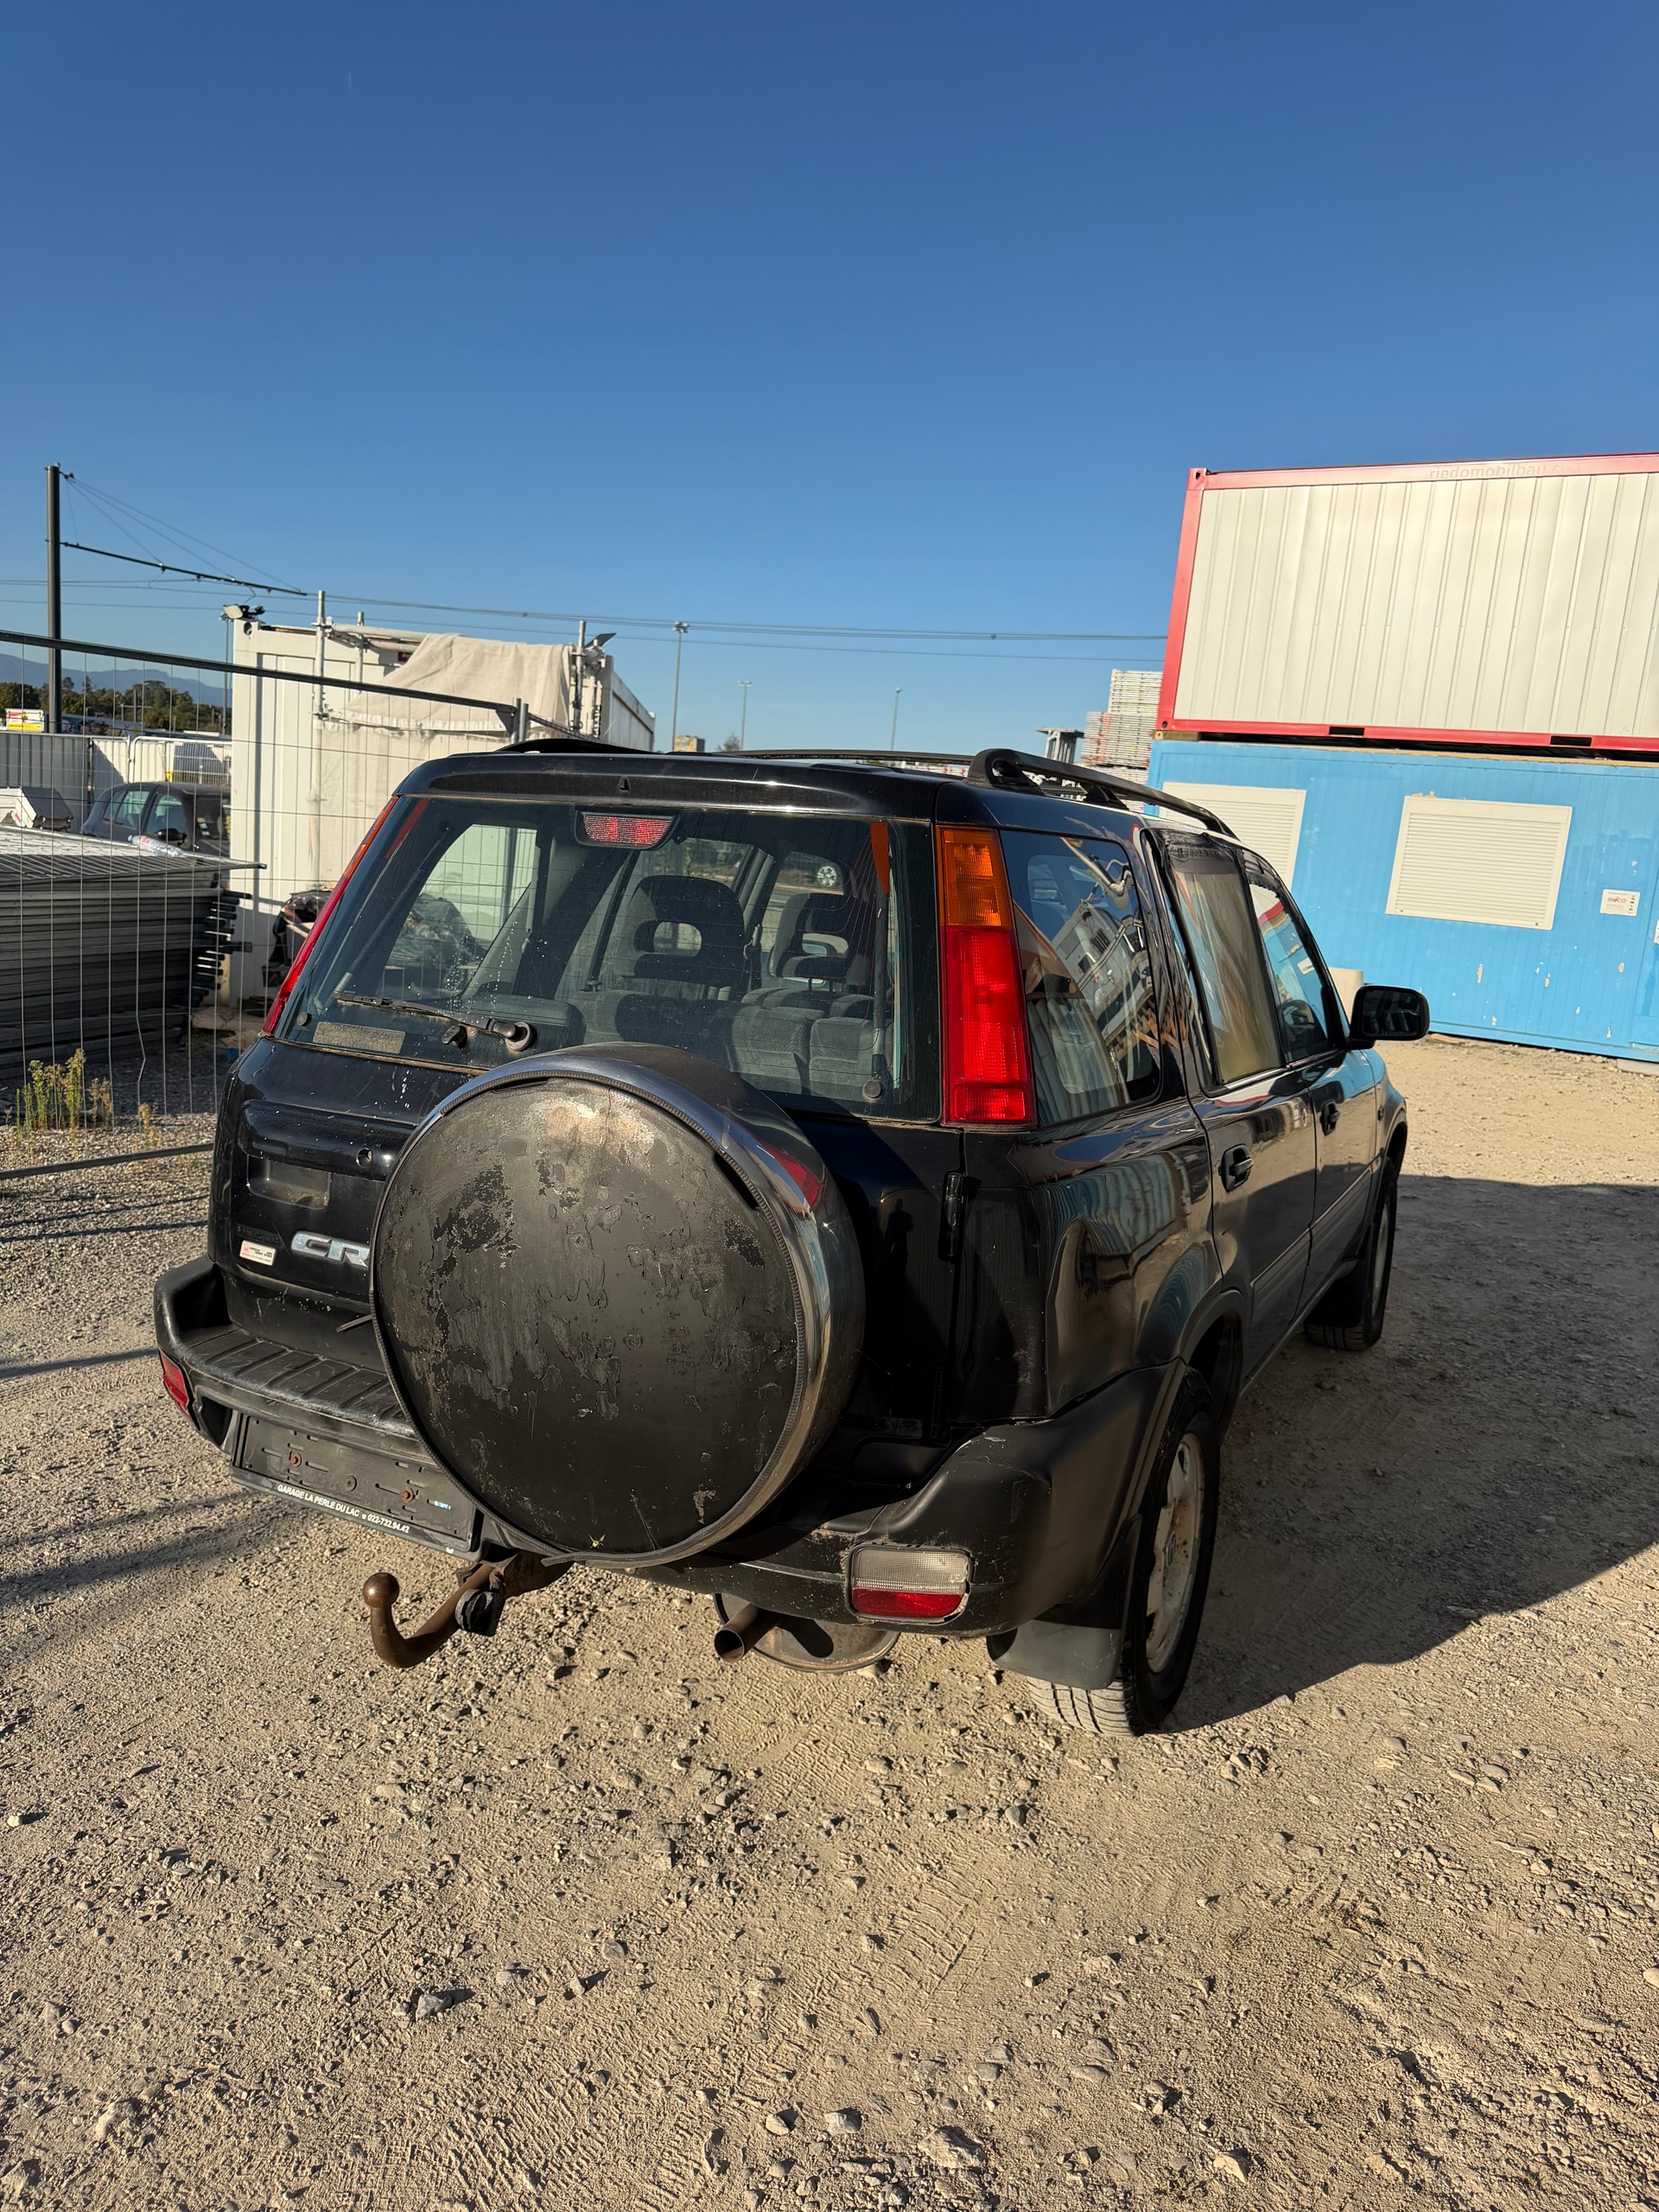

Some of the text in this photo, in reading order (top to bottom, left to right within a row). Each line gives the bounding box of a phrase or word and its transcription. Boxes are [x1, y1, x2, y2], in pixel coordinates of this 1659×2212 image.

[277, 1484, 410, 1534] GARAGE LA PERLE DU LAC 022-732.94.42
